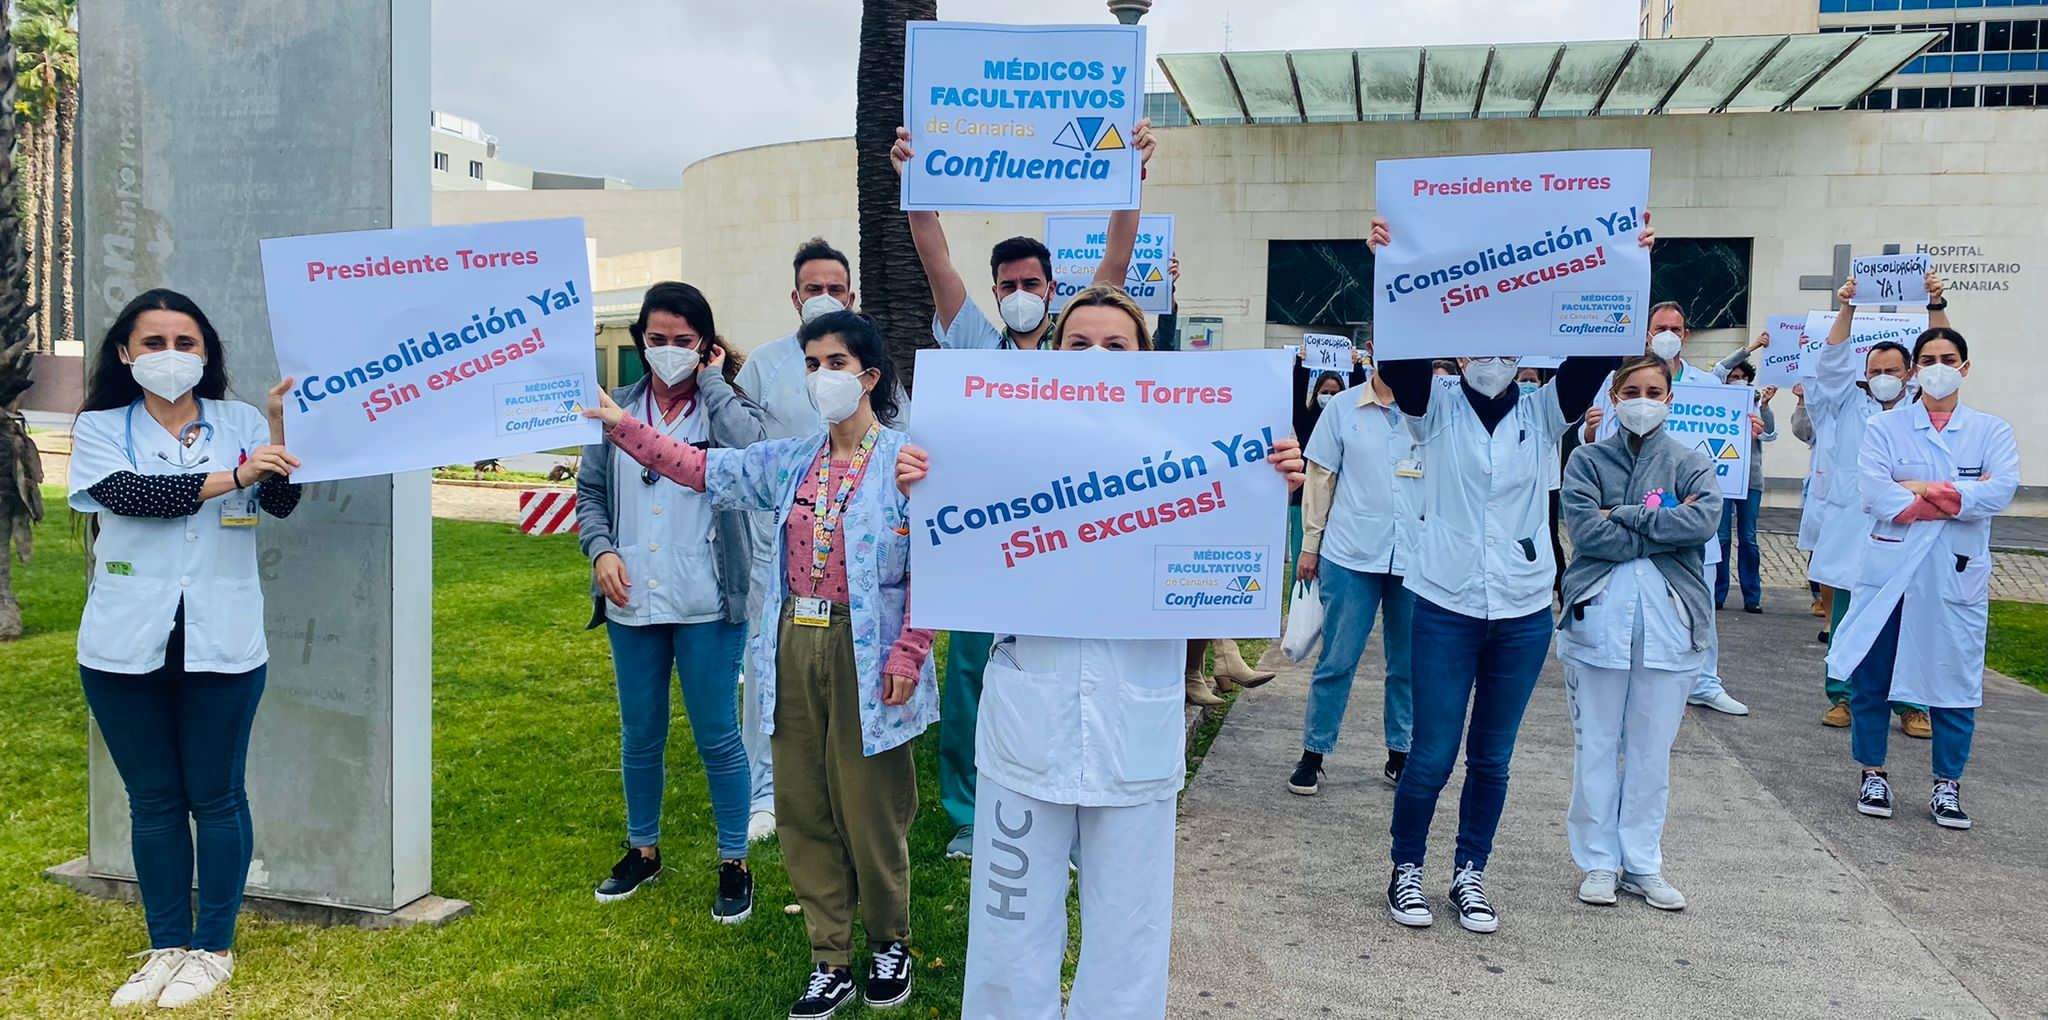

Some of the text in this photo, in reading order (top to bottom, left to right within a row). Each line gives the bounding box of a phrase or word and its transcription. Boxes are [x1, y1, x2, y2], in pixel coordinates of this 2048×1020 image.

[984, 57, 1127, 84] MÉDICOS y
[930, 86, 1126, 109] FACULTATIVOS
[926, 116, 1035, 137] de Canarias
[925, 149, 1111, 183] Confluencia
[1413, 173, 1611, 197] Presidente Torres
[1086, 232, 1164, 246] MÉOS y
[1916, 243, 1984, 256] HOSPITAL
[1057, 248, 1163, 259] FACULVOS
[1385, 206, 1638, 303] ¡Consolidación Ya!
[307, 249, 539, 282] Presidente Torres
[1930, 262, 2021, 274] NIVERSITARIO
[1440, 246, 1606, 314] ¡Sin excusas!
[1561, 303, 1631, 311] FACULTATIVOS
[1559, 323, 1625, 335] Confluencia
[293, 280, 580, 413] ¡Consolidación Ya!
[362, 327, 546, 422] ¡Sin excusas!
[525, 379, 572, 392] MÉDICOS
[964, 375, 1233, 404] Presidente Torres
[505, 388, 581, 405] FACULTATIVOS
[505, 412, 578, 431] Confluencia
[1731, 409, 1741, 422] y
[925, 425, 1275, 546] ¡Consolidación Ya!
[1001, 481, 1227, 568] ¡Sin excusas!
[1193, 548, 1262, 562] MÉDICOS y
[1167, 563, 1261, 573] FACULTATIVOS
[1165, 592, 1254, 608] Confluencia
[986, 799, 1033, 920] HUC
